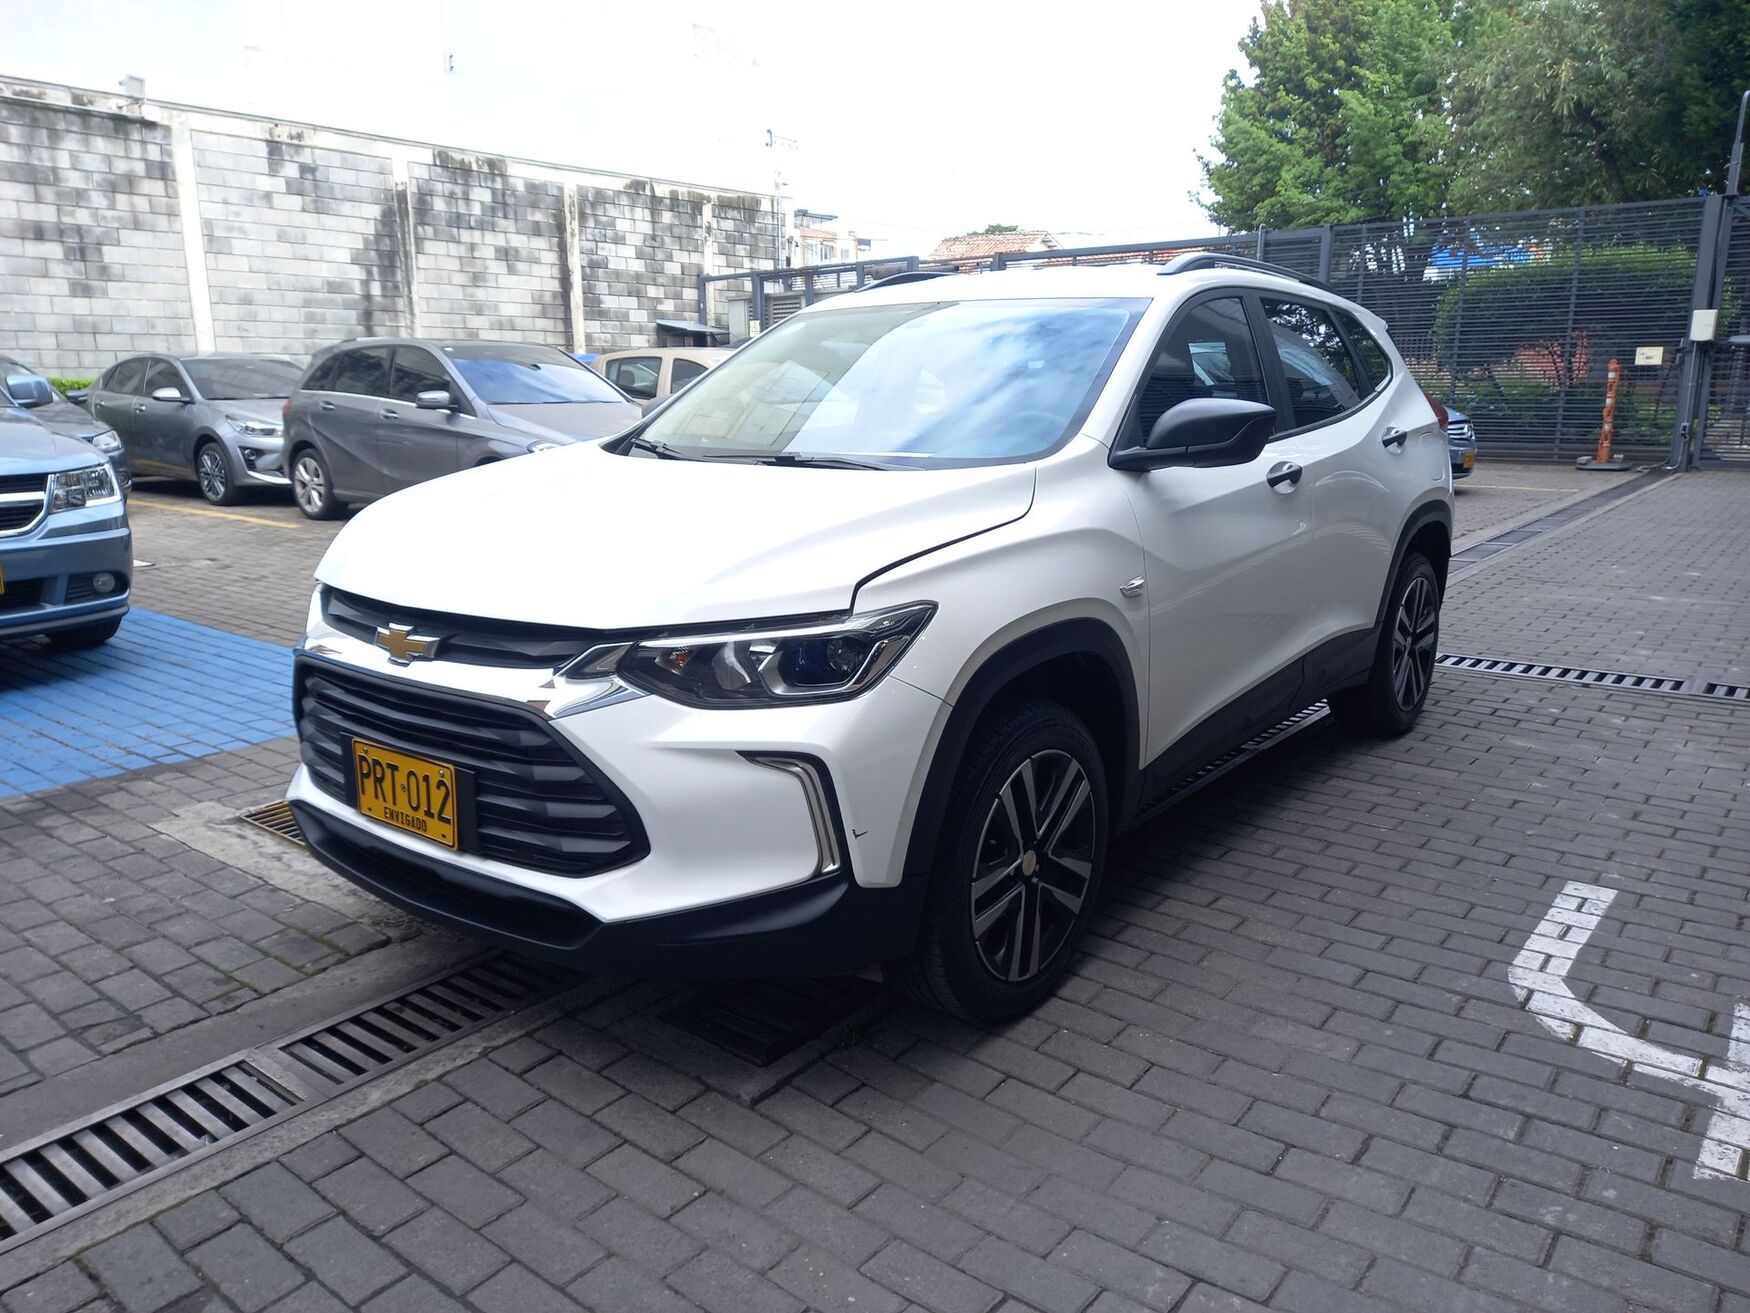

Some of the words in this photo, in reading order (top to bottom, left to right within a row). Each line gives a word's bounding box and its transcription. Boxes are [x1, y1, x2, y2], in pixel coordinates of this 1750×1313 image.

[358, 754, 399, 806] PRT
[407, 770, 452, 825] 012
[383, 806, 428, 833] ENVIGADO
